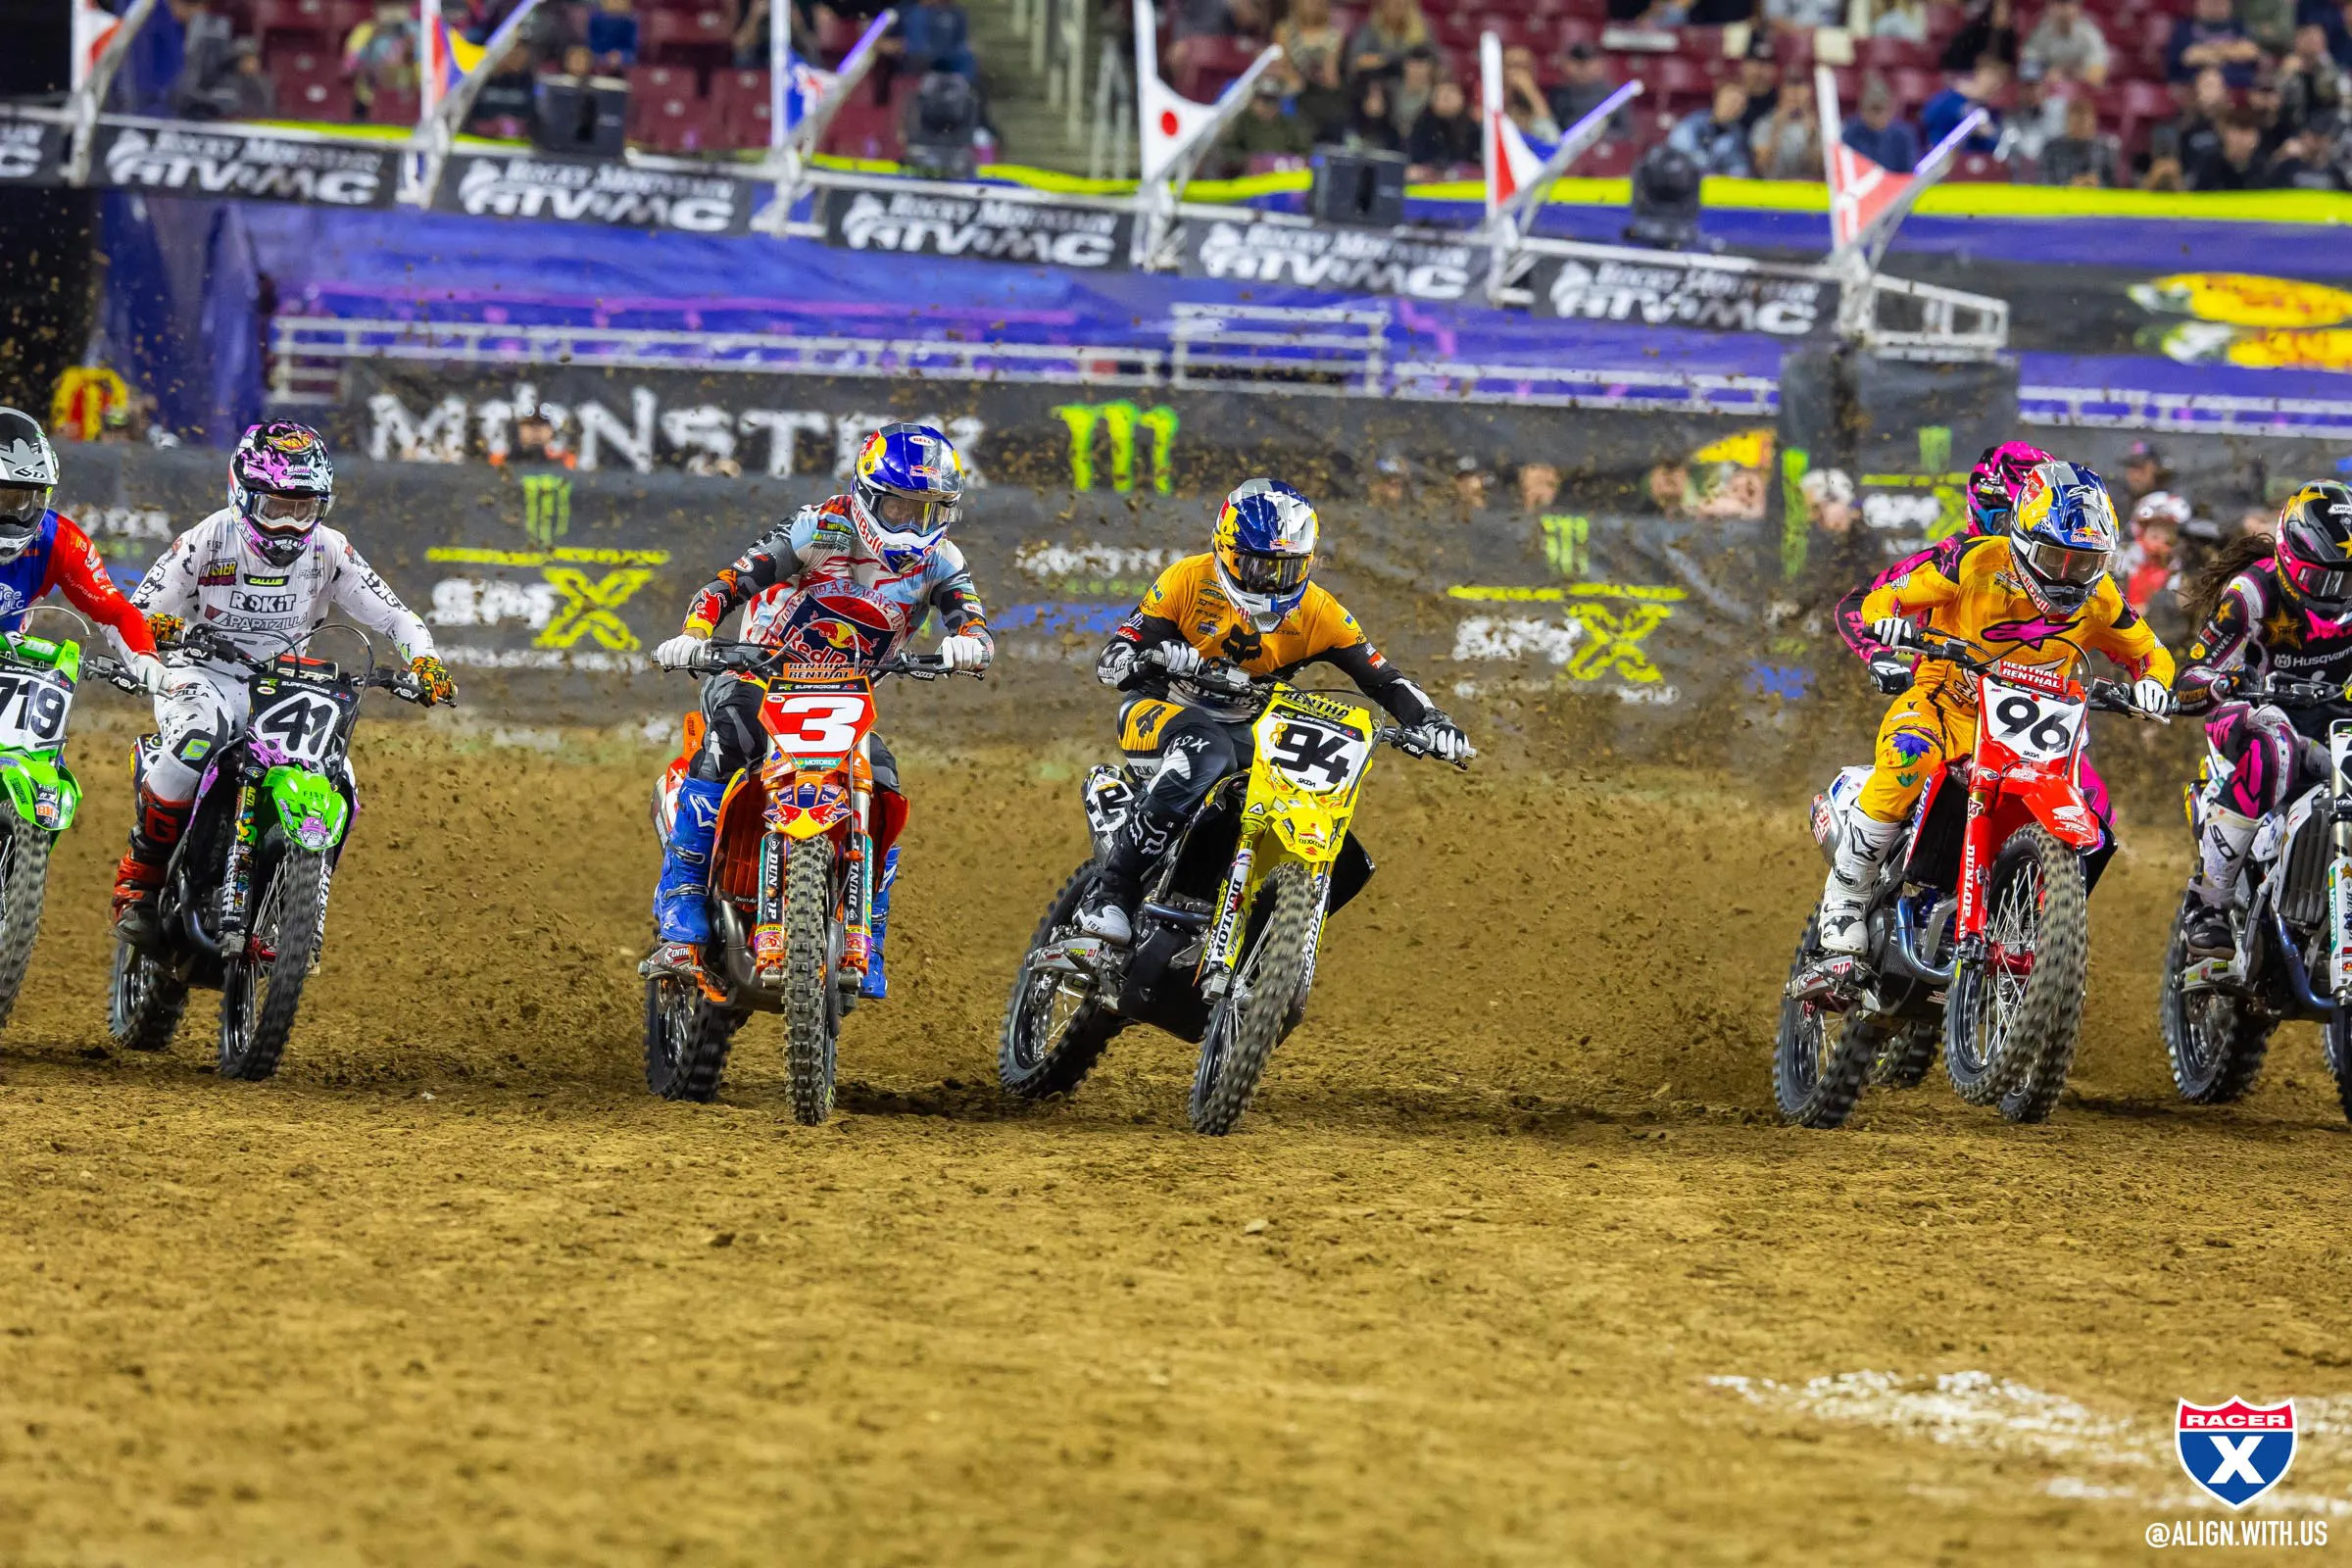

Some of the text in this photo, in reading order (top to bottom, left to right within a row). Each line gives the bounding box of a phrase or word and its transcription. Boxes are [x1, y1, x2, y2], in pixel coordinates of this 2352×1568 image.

[184, 646, 209, 659] ASV
[393, 687, 418, 700] ASV
[2001, 668, 2061, 688] RENTHAL
[261, 696, 334, 758] 41
[774, 696, 865, 754] 3
[1995, 696, 2074, 755] 96
[1270, 723, 1349, 784] 94
[1403, 742, 1424, 755] ASV
[1963, 845, 1976, 917] DUNLOP
[1088, 920, 1102, 931] FOX
